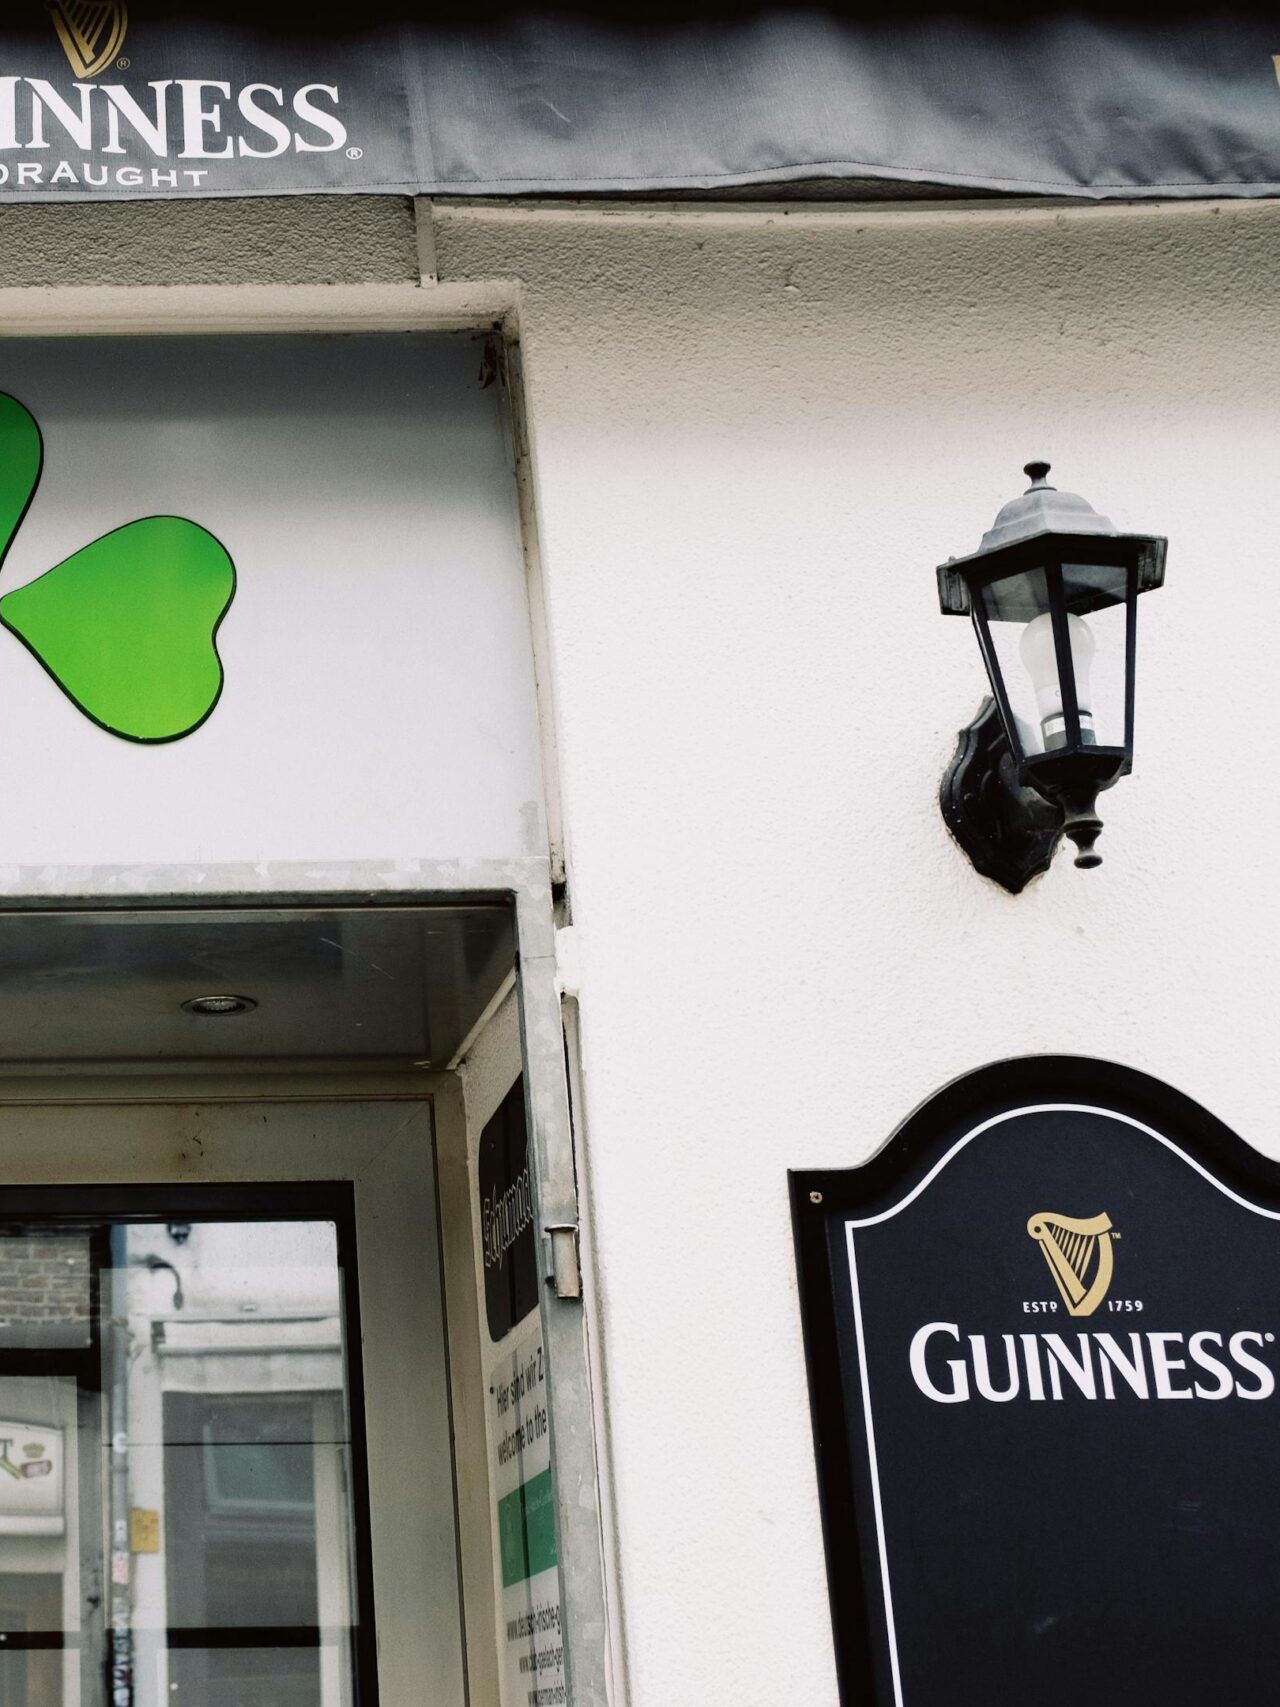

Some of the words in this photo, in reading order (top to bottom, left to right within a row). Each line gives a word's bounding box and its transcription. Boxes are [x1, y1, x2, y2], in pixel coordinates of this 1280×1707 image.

[1108, 1300, 1144, 1312] 1759
[909, 1321, 1276, 1403] GUINNESS
[498, 1429, 526, 1466] welcome
[527, 1416, 534, 1446] to
